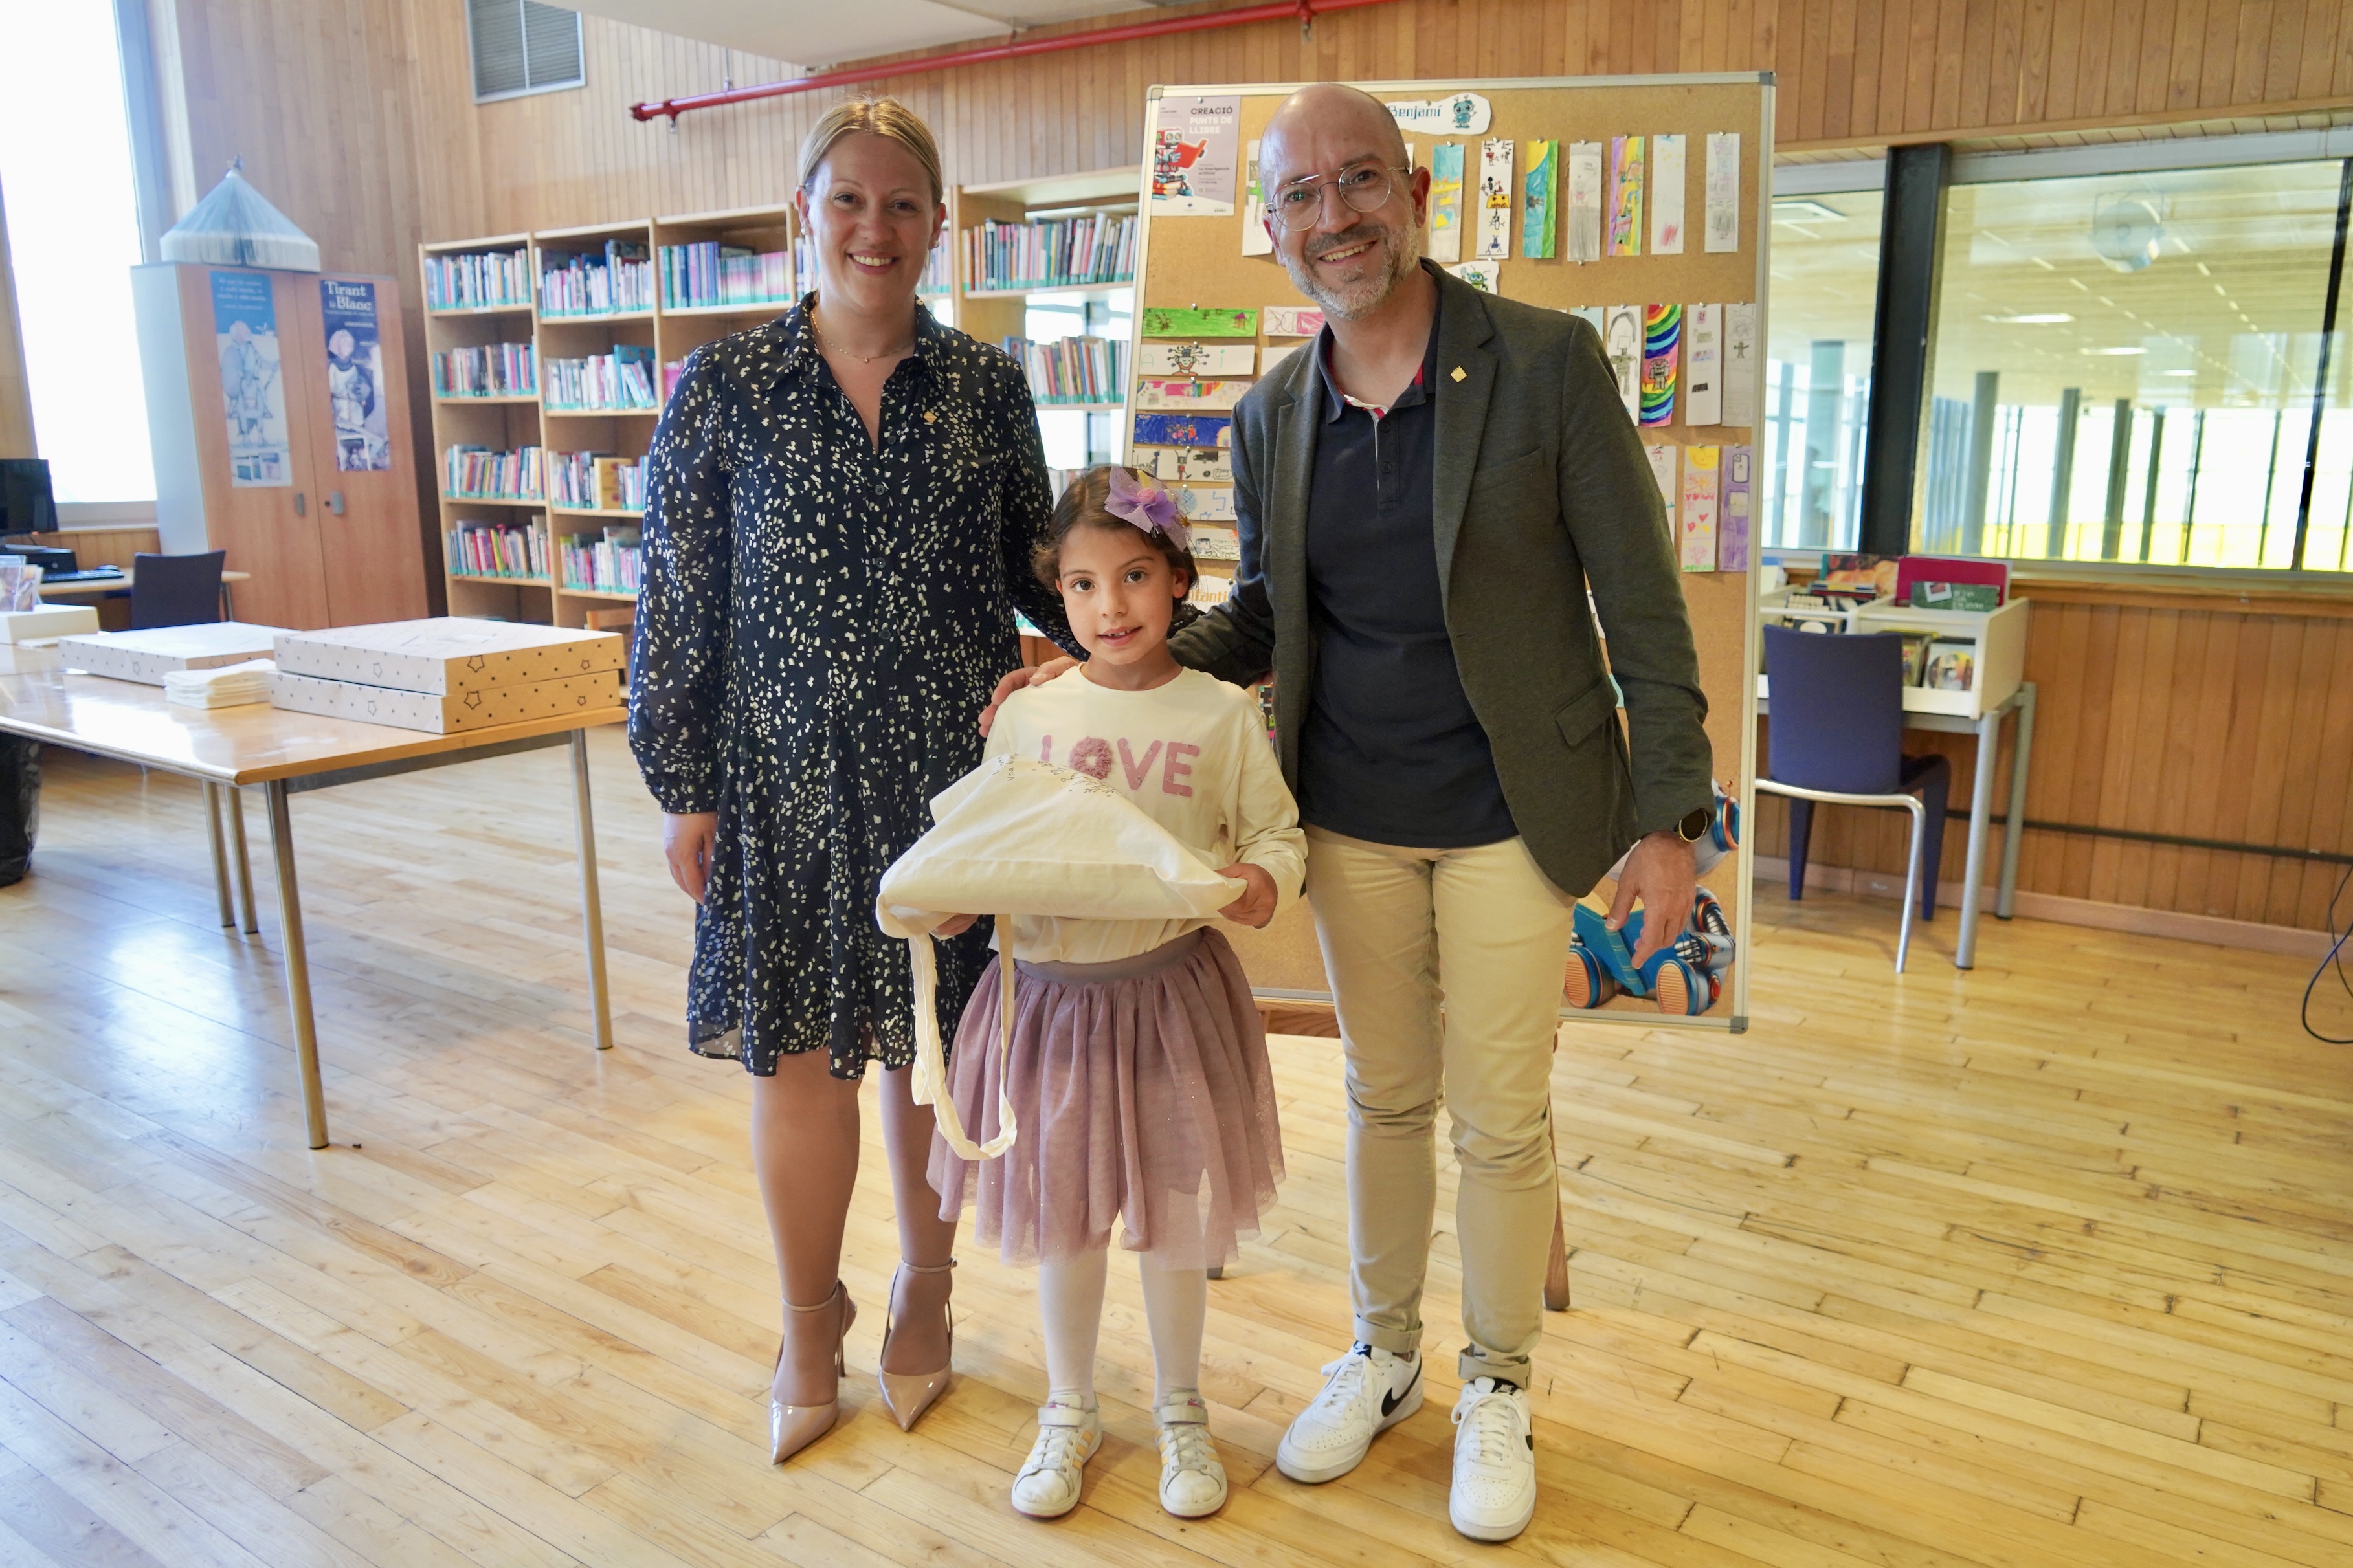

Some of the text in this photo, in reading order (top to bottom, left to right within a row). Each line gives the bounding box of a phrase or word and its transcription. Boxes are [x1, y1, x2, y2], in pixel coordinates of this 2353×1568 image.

[1191, 105, 1233, 115] CREACIÓ
[1388, 105, 1442, 120] Benjamí
[324, 280, 366, 296] Tirant
[337, 296, 372, 311] Blanc
